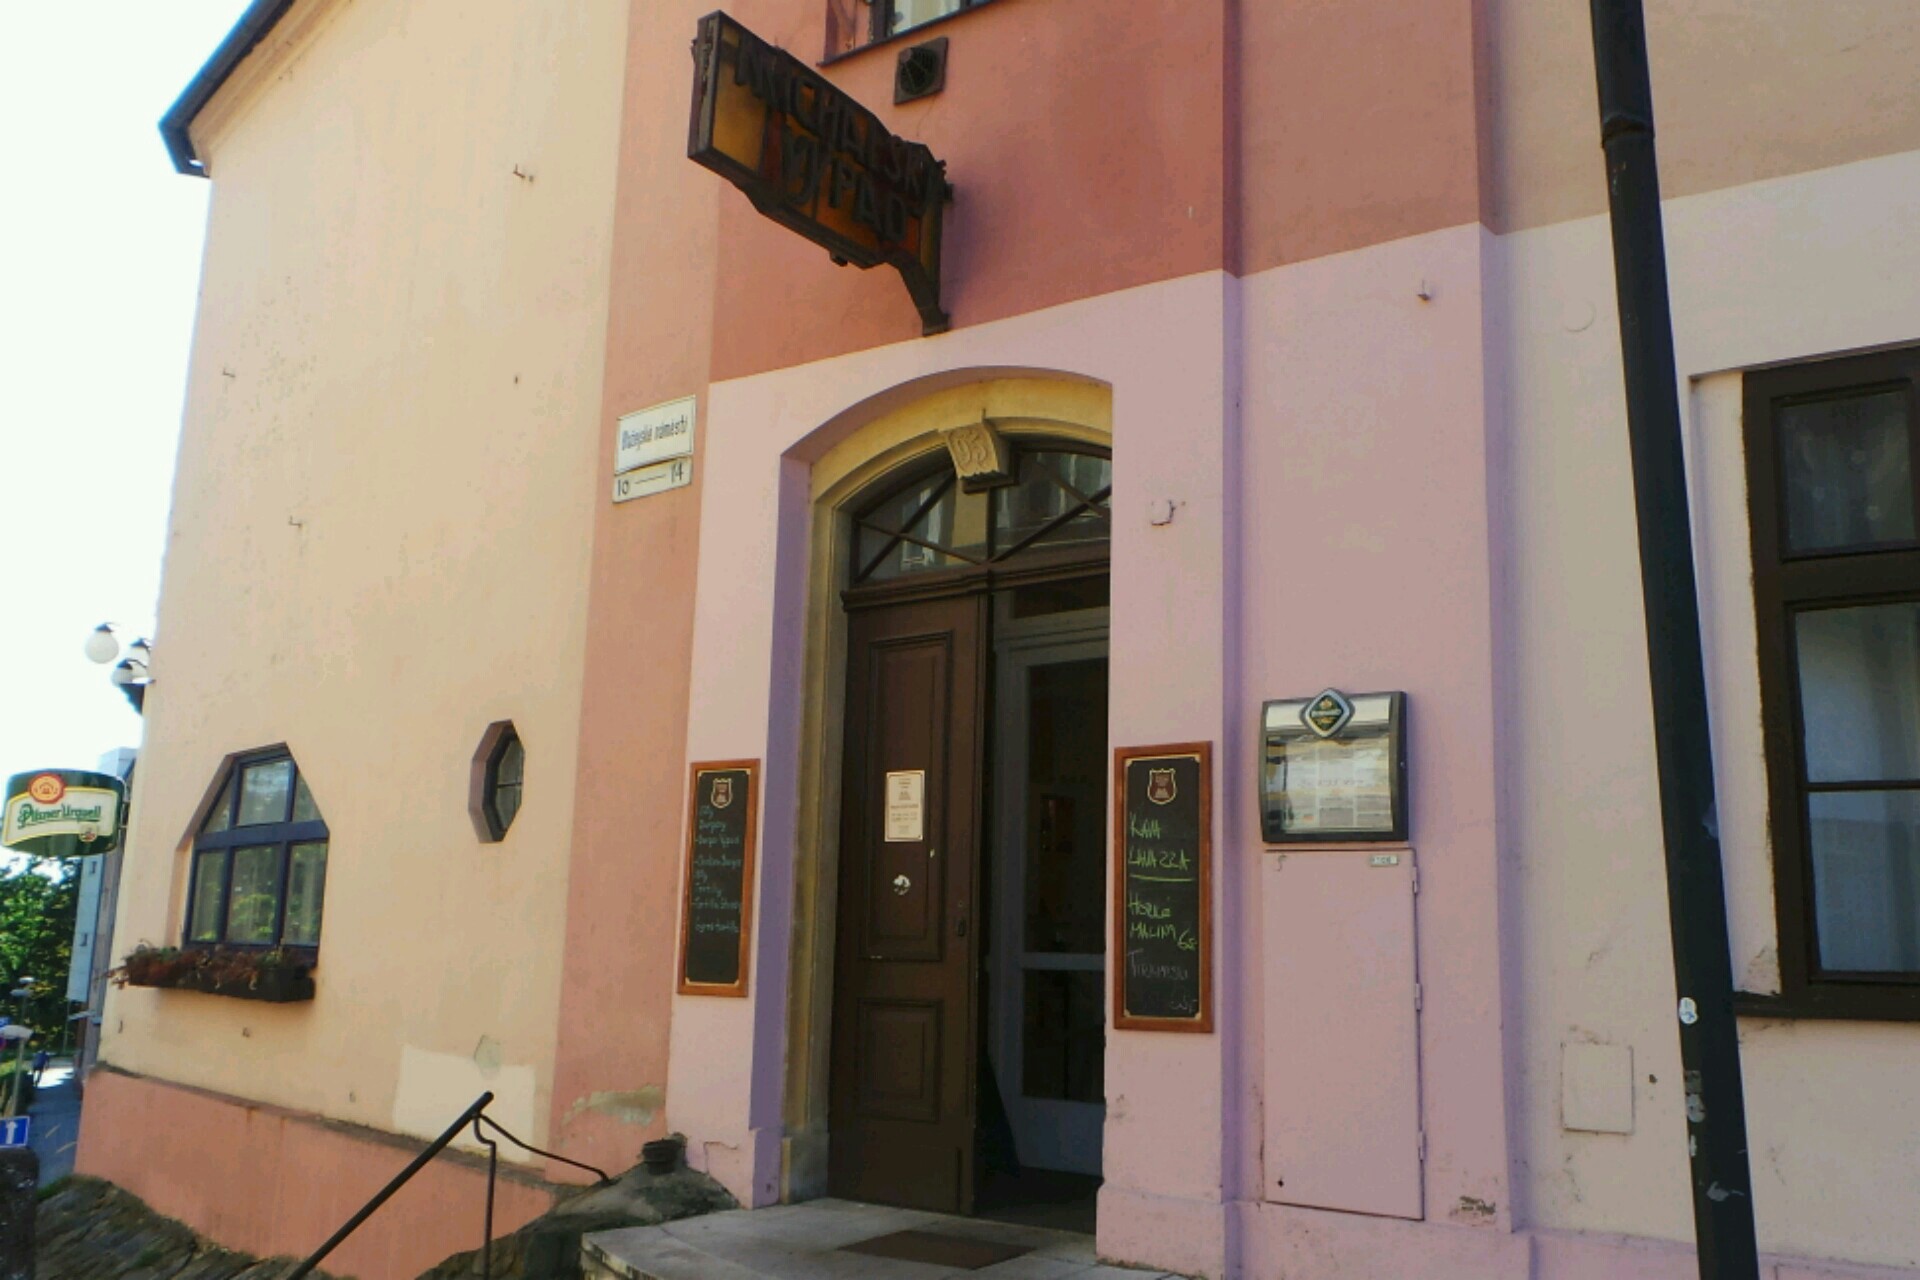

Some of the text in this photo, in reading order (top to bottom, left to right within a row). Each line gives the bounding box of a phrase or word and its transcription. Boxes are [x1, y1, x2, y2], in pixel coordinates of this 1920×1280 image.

[618, 462, 684, 496] 10 14
[61, 803, 101, 823] Urquell
